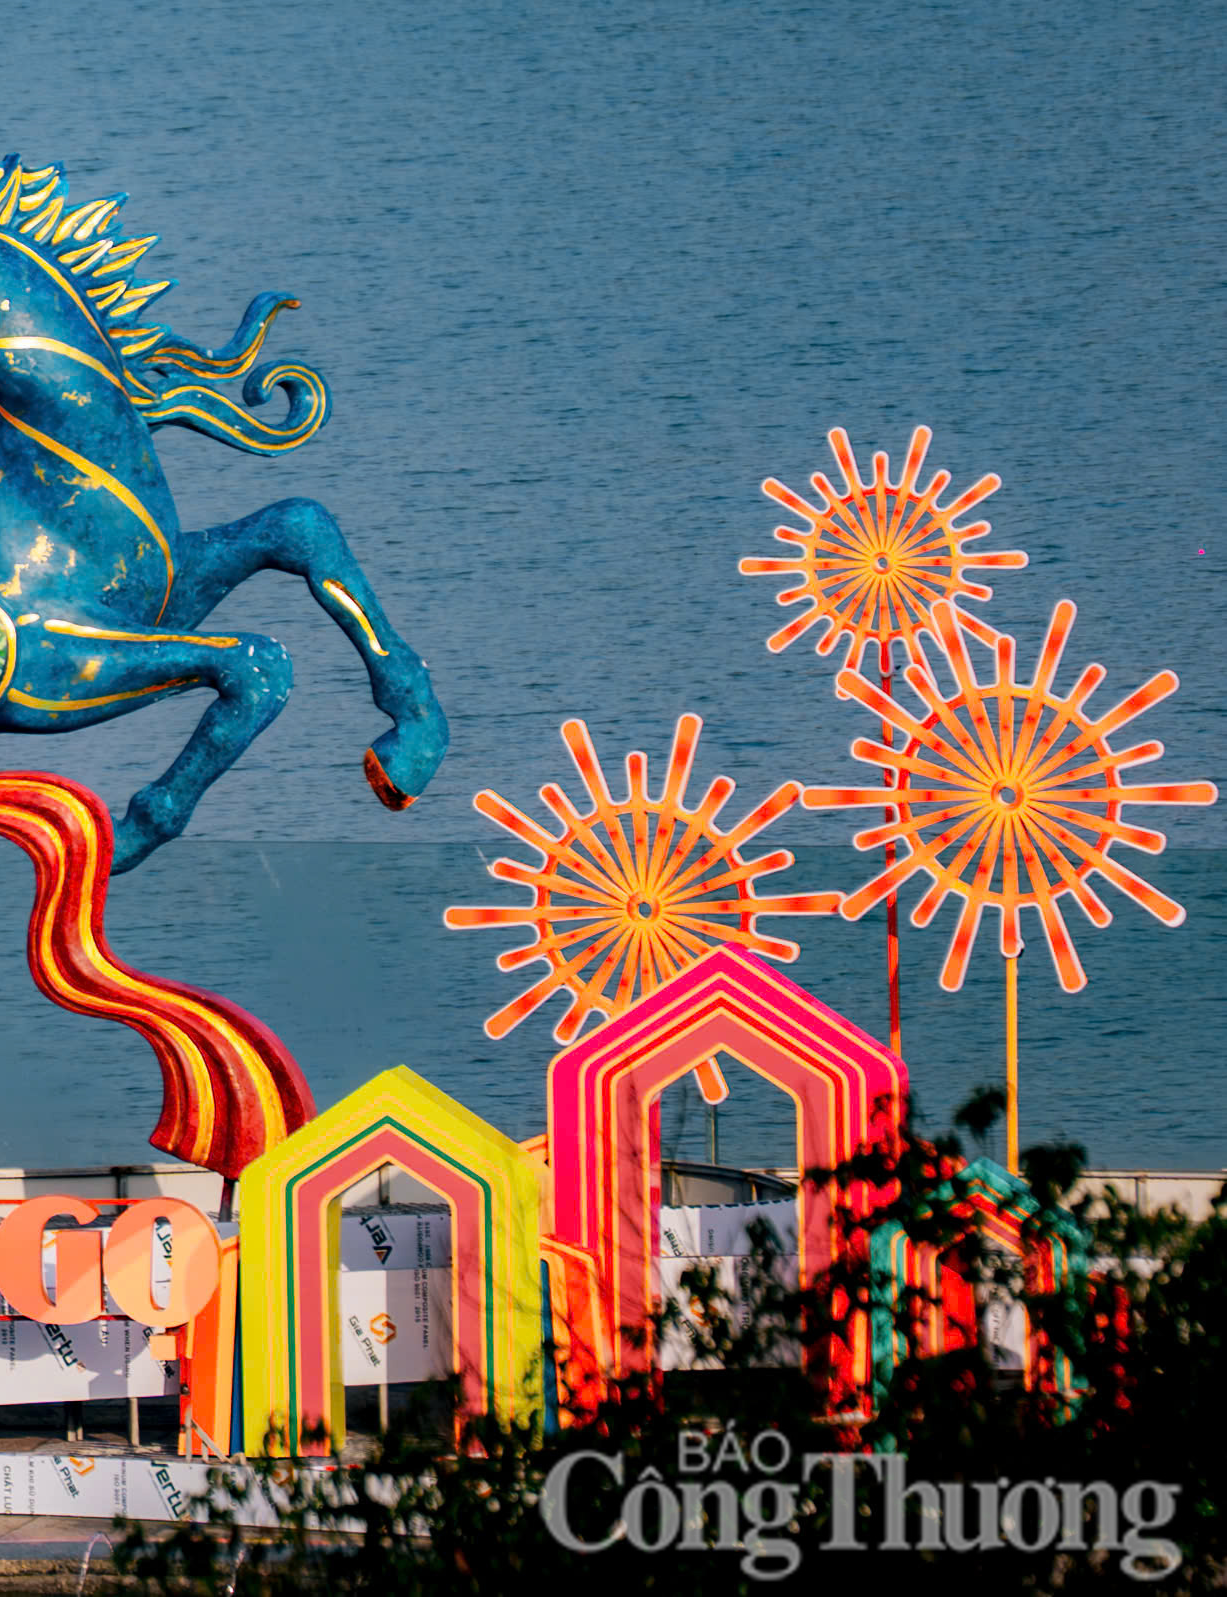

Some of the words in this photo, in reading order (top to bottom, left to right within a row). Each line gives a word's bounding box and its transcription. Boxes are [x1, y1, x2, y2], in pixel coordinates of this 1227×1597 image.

[44, 1324, 78, 1367] ertu
[349, 1315, 364, 1338] Gia
[362, 1337, 382, 1368] Phat
[3, 1465, 13, 1493] CHẤT
[60, 1467, 80, 1499] Phat
